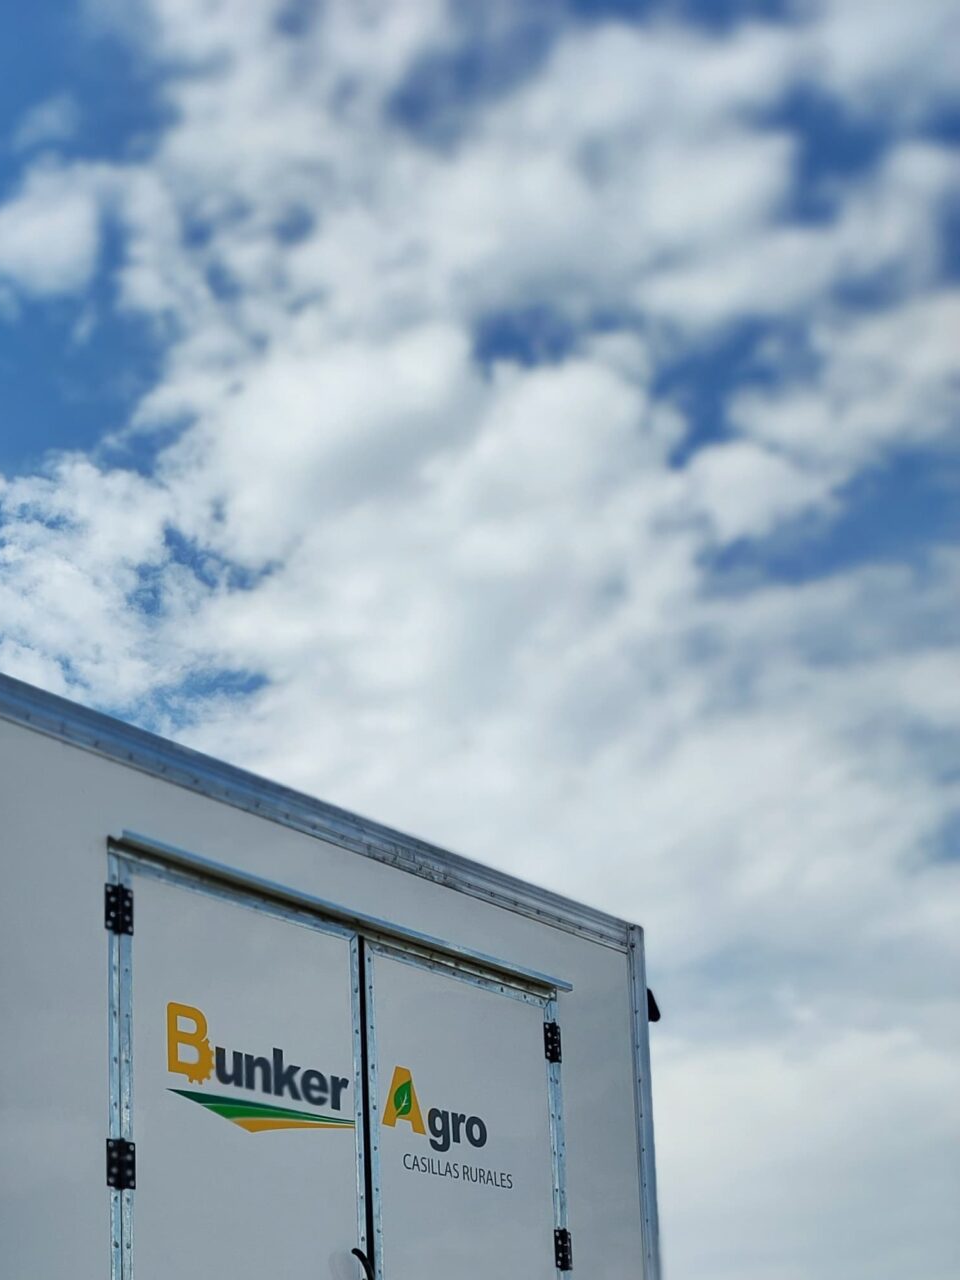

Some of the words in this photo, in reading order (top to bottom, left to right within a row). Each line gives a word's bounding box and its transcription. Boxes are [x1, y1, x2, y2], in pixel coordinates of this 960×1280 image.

[167, 1002, 349, 1111] Bunker
[381, 1065, 488, 1152] Agro
[402, 1152, 460, 1181] CASILLAS
[462, 1166, 514, 1190] RURALES
